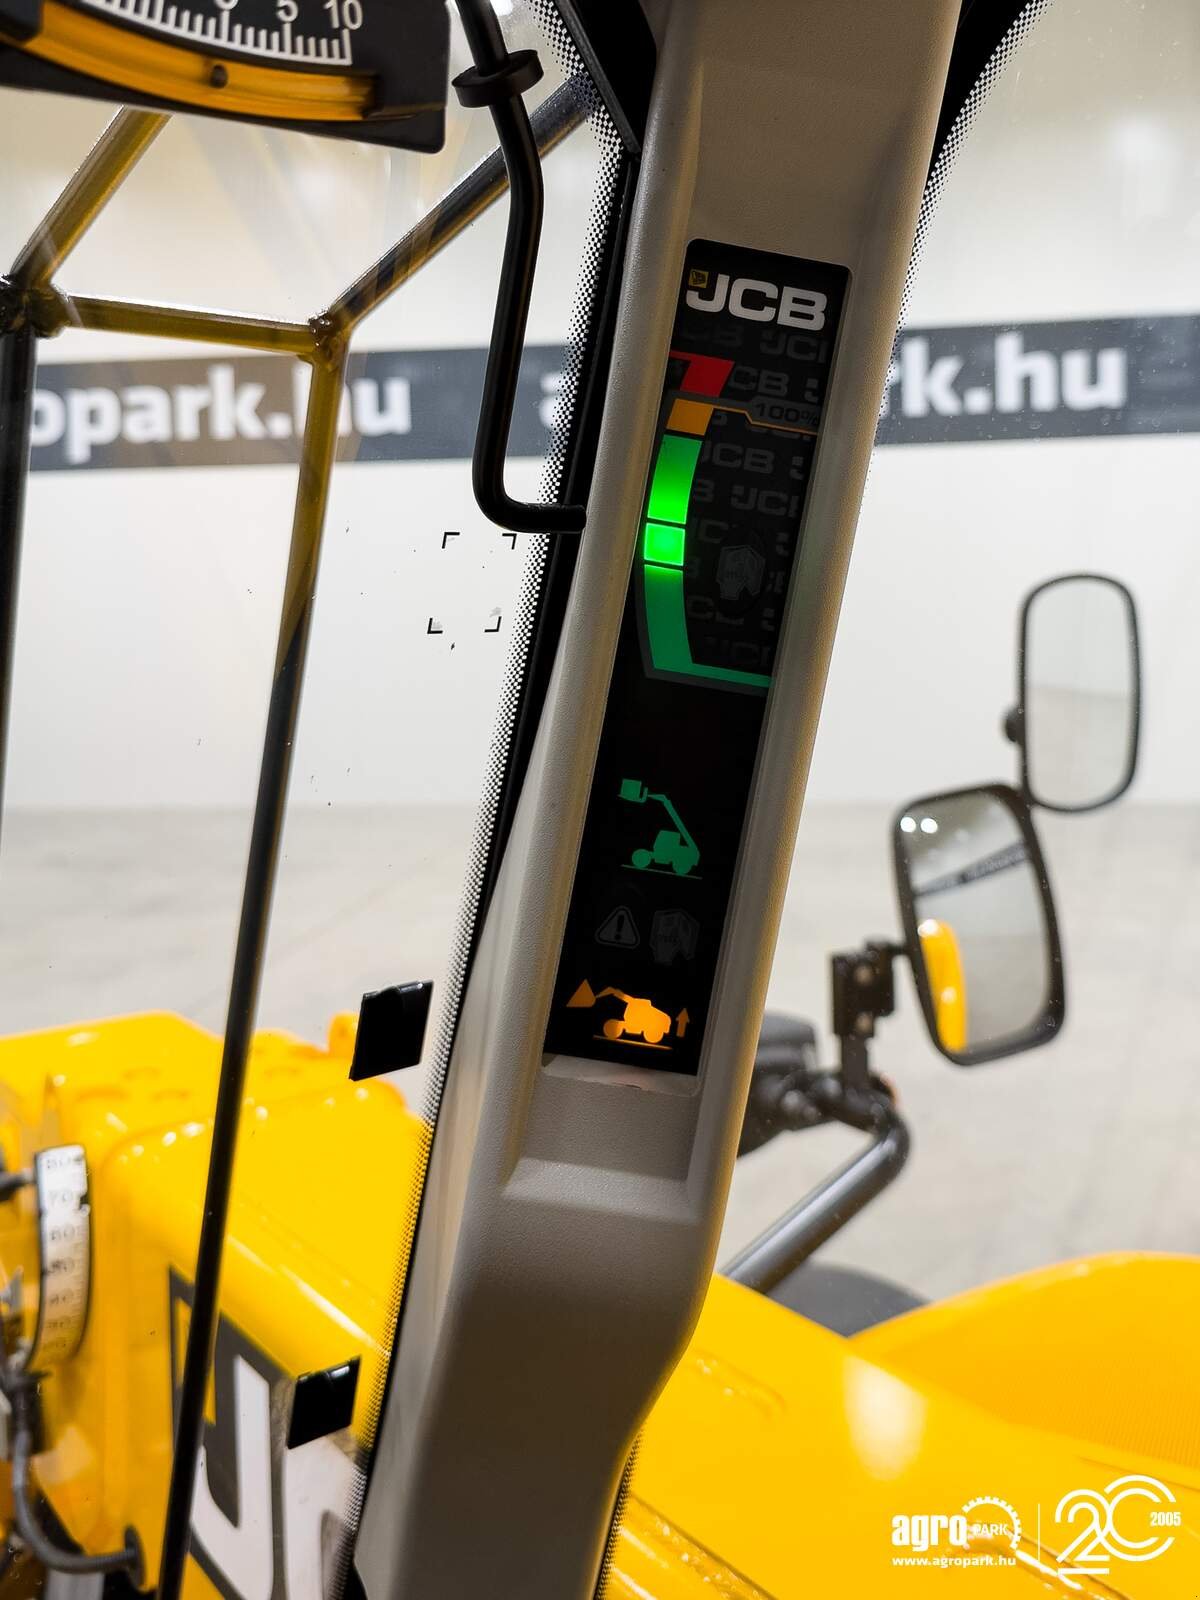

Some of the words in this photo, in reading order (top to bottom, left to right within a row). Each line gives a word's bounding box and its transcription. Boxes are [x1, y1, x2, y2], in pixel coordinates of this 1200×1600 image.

[276, 0, 299, 22] 5
[323, 0, 363, 30] 10
[686, 272, 828, 331] JCB
